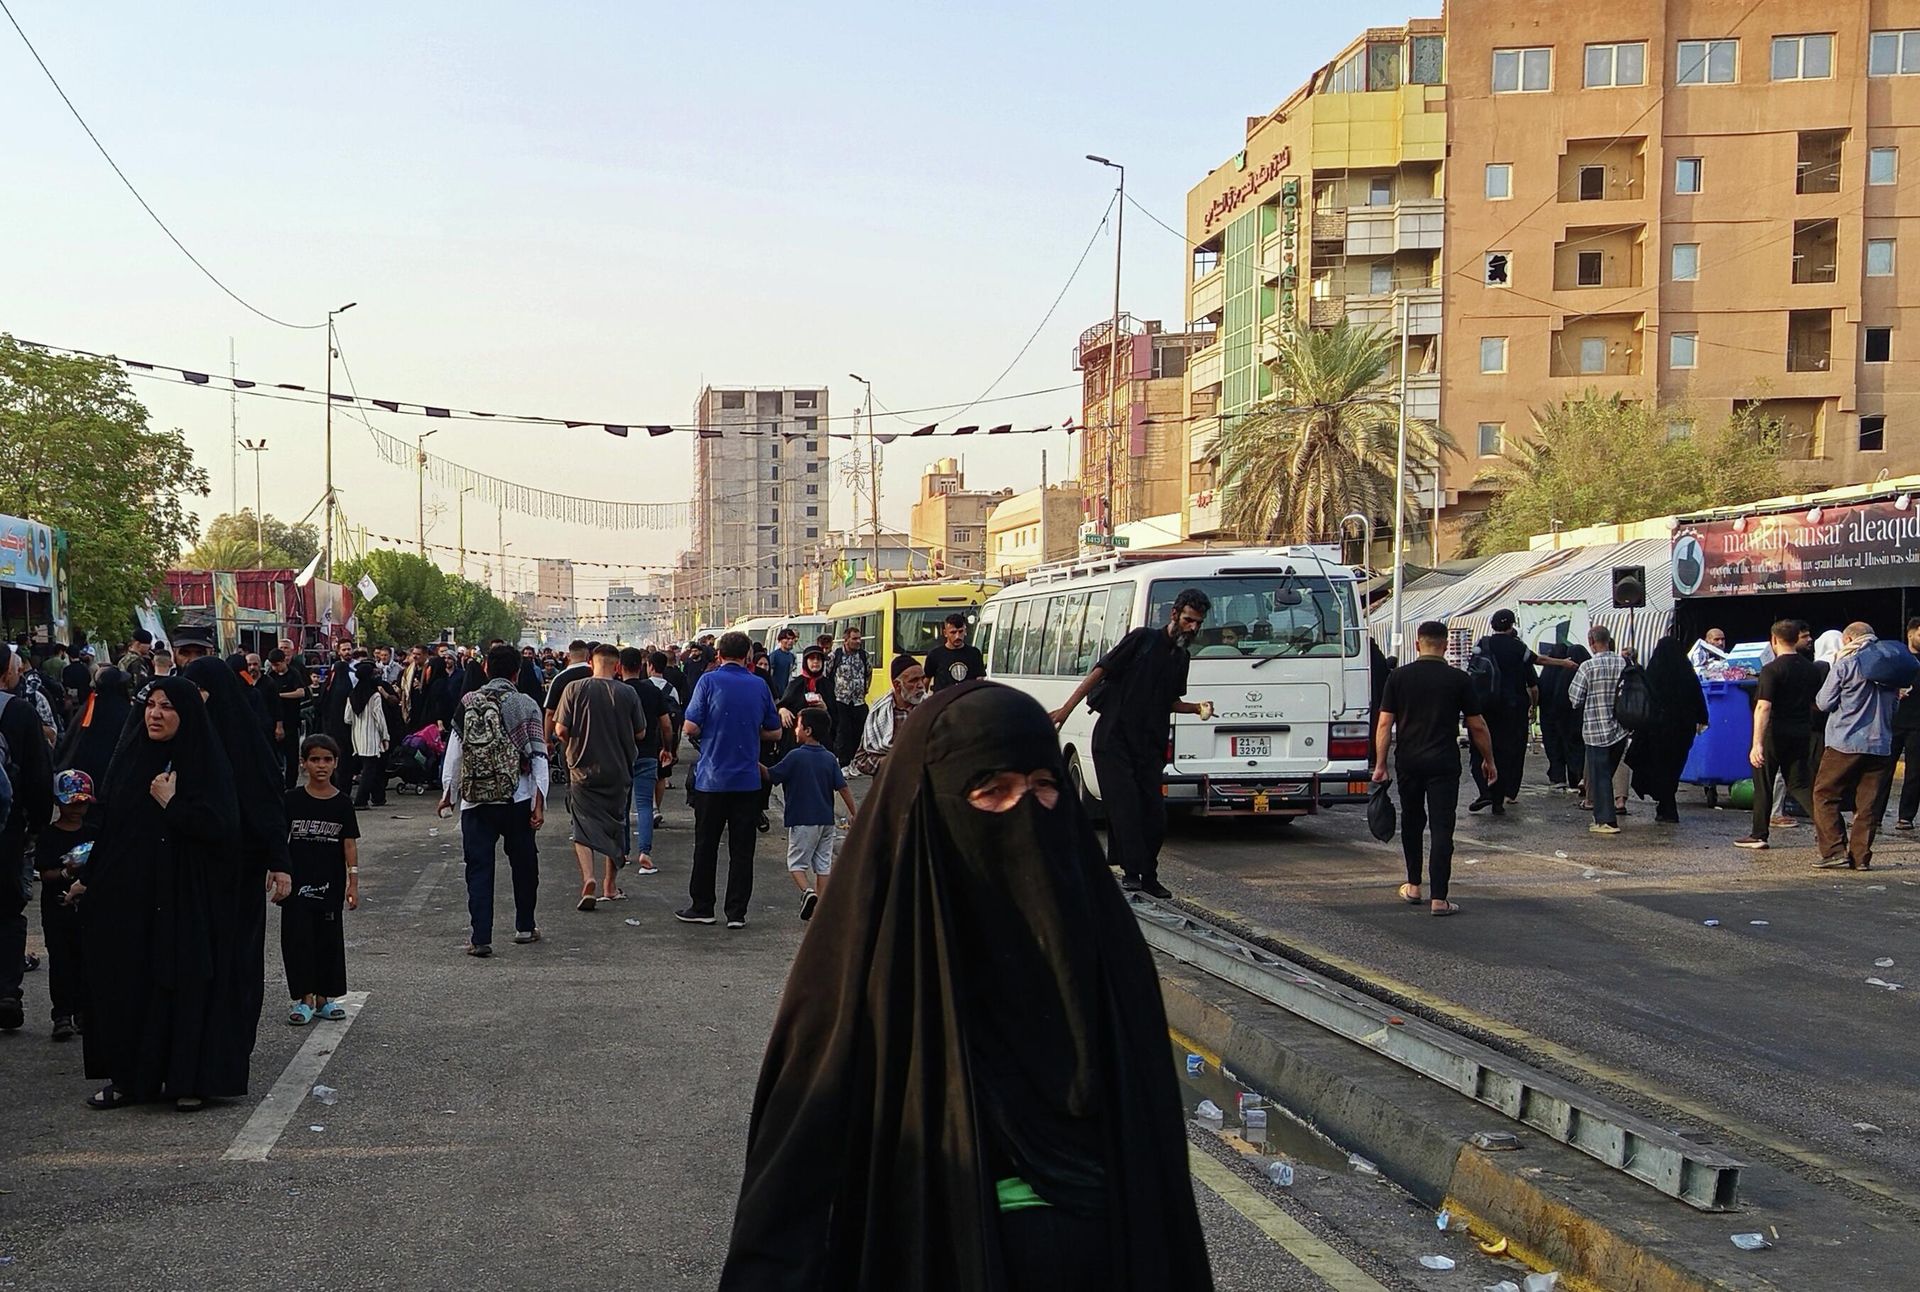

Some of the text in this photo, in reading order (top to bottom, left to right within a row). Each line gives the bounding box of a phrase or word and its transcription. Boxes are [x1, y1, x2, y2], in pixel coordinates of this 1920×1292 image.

[1282, 181, 1298, 249] HOTEL
[1724, 519, 1789, 553] mawkib
[1794, 523, 1844, 548] ansar
[1814, 554, 1833, 571] grand
[1834, 553, 1853, 568] father
[1891, 554, 1904, 564] was
[1837, 577, 1852, 586] Street
[1221, 711, 1284, 719] COASTER
[1239, 738, 1265, 746] 21 A
[1239, 746, 1268, 755] 32970
